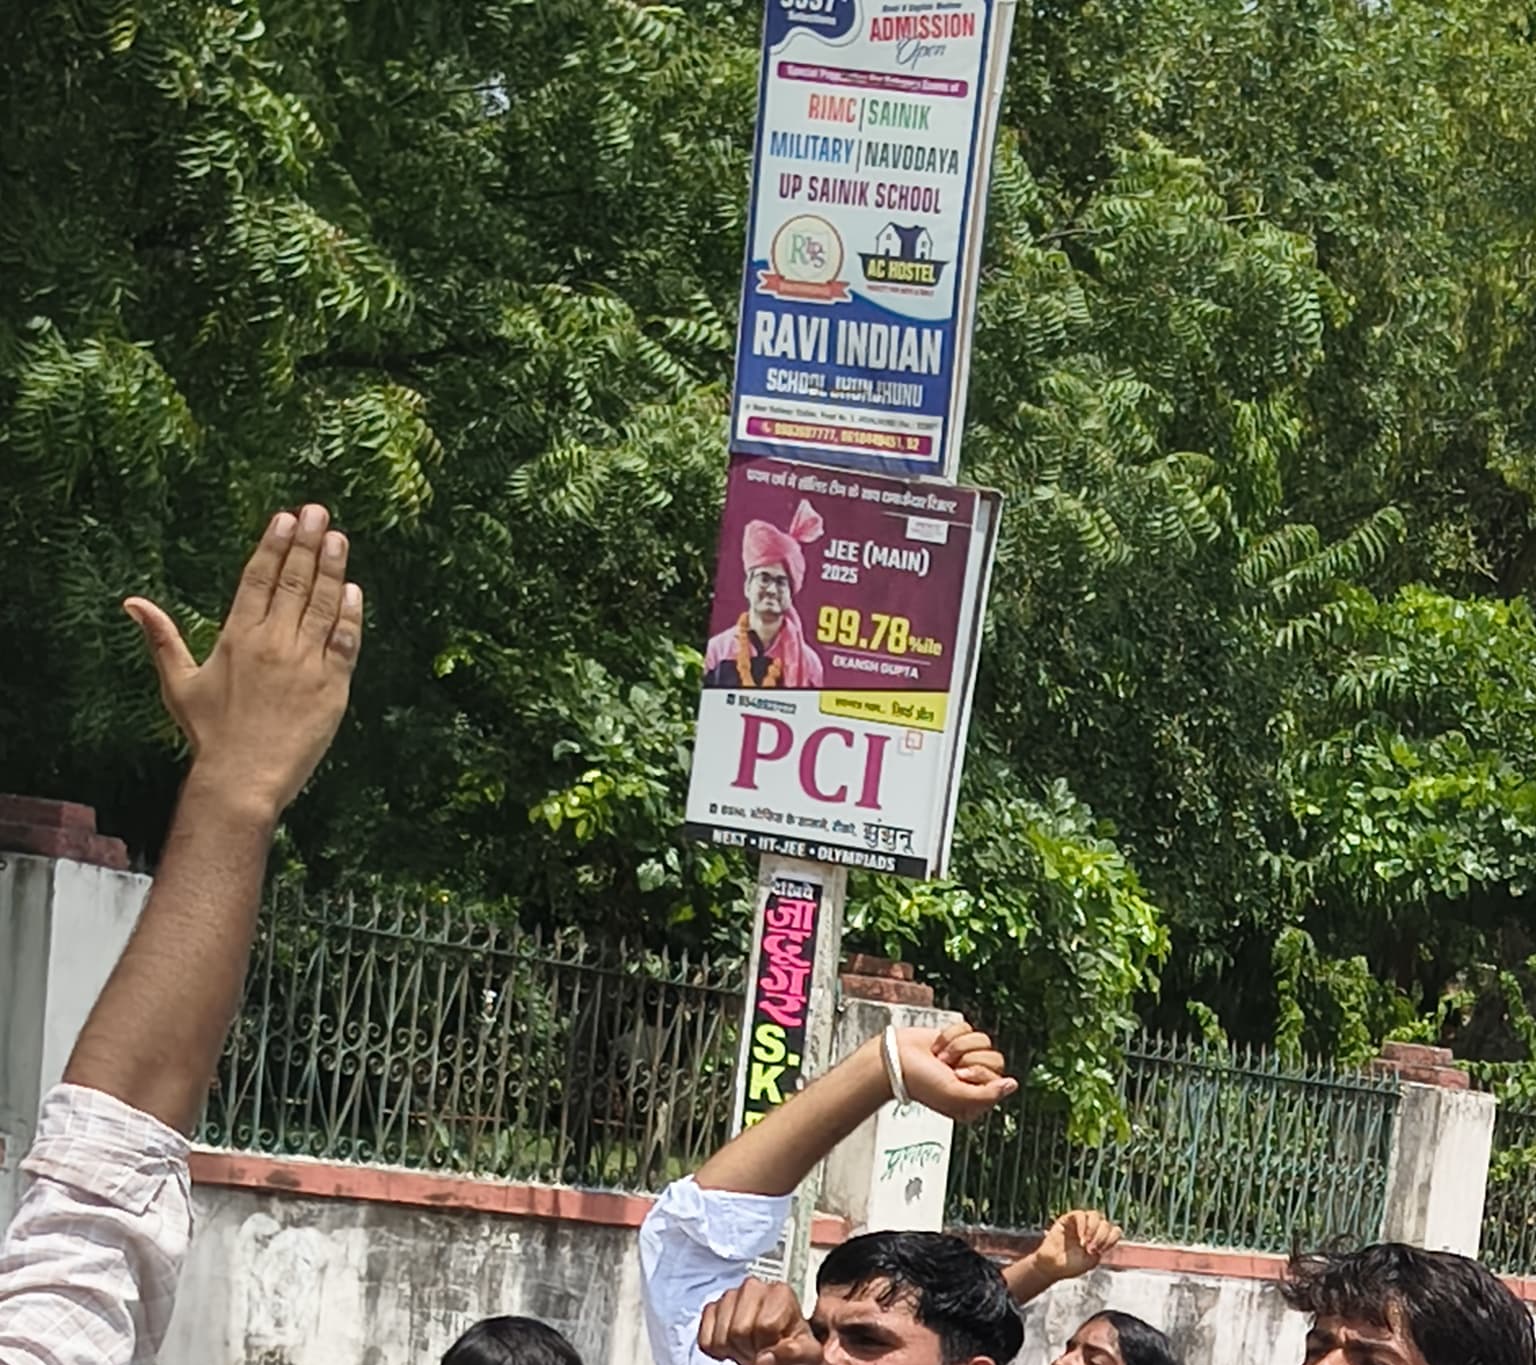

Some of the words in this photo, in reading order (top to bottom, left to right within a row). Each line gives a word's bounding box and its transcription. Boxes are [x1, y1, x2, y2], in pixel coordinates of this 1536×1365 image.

[869, 13, 976, 42] ADMISSION
[896, 38, 947, 70] Open
[808, 93, 857, 123] RIMC
[867, 99, 931, 130] SAINIK
[770, 131, 855, 164] MILITARY
[864, 141, 960, 175] NAVODAYA
[779, 173, 802, 199] UP
[807, 176, 870, 207] SAINIK
[874, 183, 942, 215] SCHOOL
[867, 259, 886, 278] AC
[888, 260, 935, 283] HOSTEL
[752, 310, 829, 363] RAVI
[835, 320, 943, 375] INDIAN
[766, 368, 828, 396] SCHOOL
[821, 563, 859, 583] 2025
[824, 538, 860, 562] JEE
[863, 540, 930, 577] (MAIN)
[730, 713, 891, 810] PCI
[817, 845, 897, 872] OLYMPIADS
